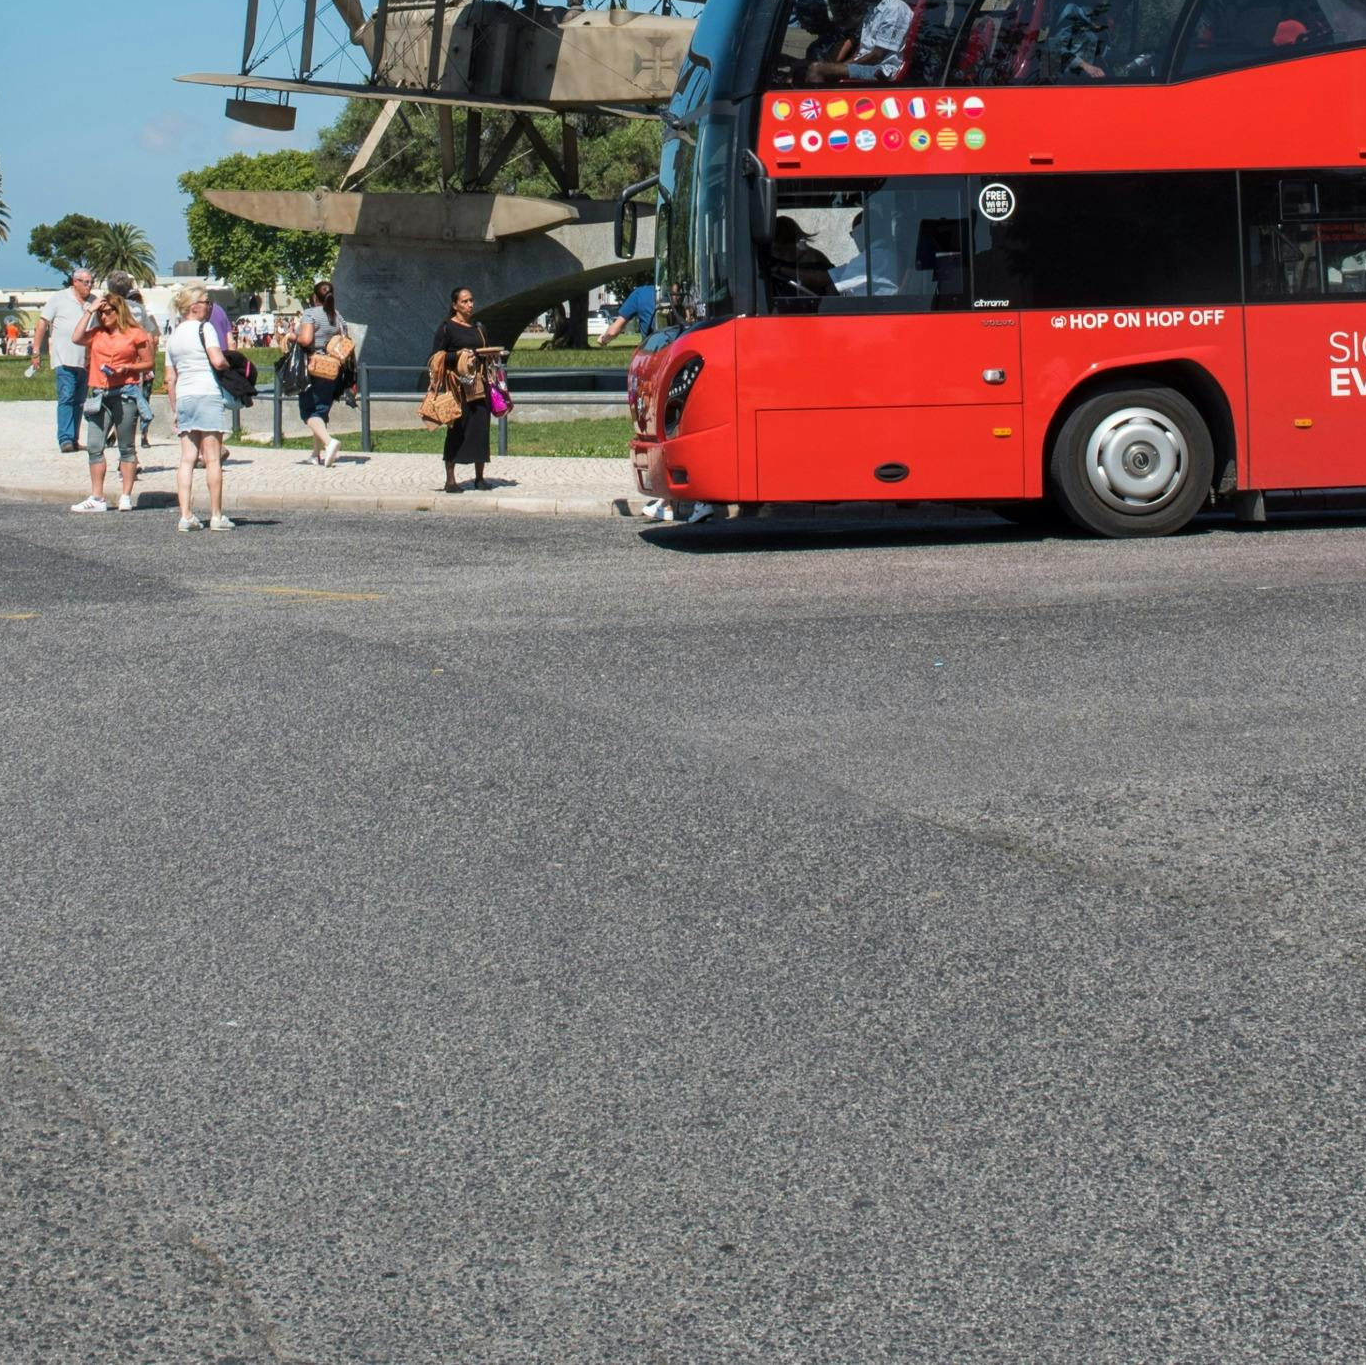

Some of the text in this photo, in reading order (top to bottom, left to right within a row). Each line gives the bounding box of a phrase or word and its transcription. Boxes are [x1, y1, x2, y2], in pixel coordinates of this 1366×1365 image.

[985, 190, 1007, 201] FREE
[974, 299, 1010, 308] cityrama
[981, 319, 1016, 327] VOLVO
[1069, 309, 1225, 330] HOP ON HOP OFF
